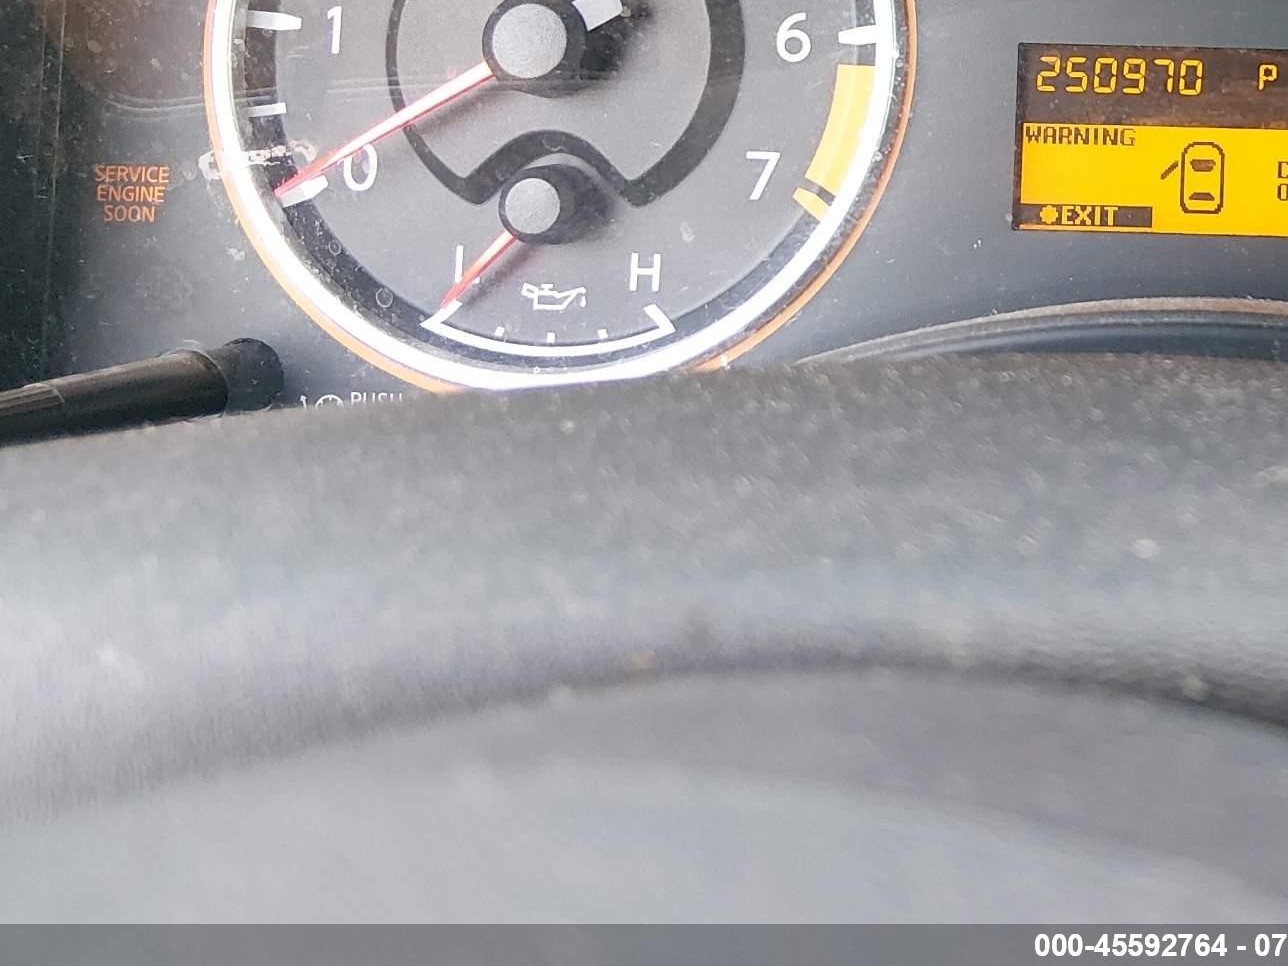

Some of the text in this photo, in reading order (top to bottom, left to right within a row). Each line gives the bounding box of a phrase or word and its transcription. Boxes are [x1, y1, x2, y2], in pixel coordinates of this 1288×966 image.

[327, 6, 342, 56] 1
[776, 12, 812, 62] 6
[1036, 56, 1204, 96] 250970
[1257, 64, 1278, 91] P
[1026, 126, 1136, 146] WARNING
[95, 165, 170, 183] SERVICE
[343, 144, 378, 192] 0
[746, 151, 781, 200] 7
[96, 185, 166, 203] ENGINE
[103, 205, 156, 222] SOON
[1061, 205, 1119, 226] EXIT
[629, 252, 661, 291] H
